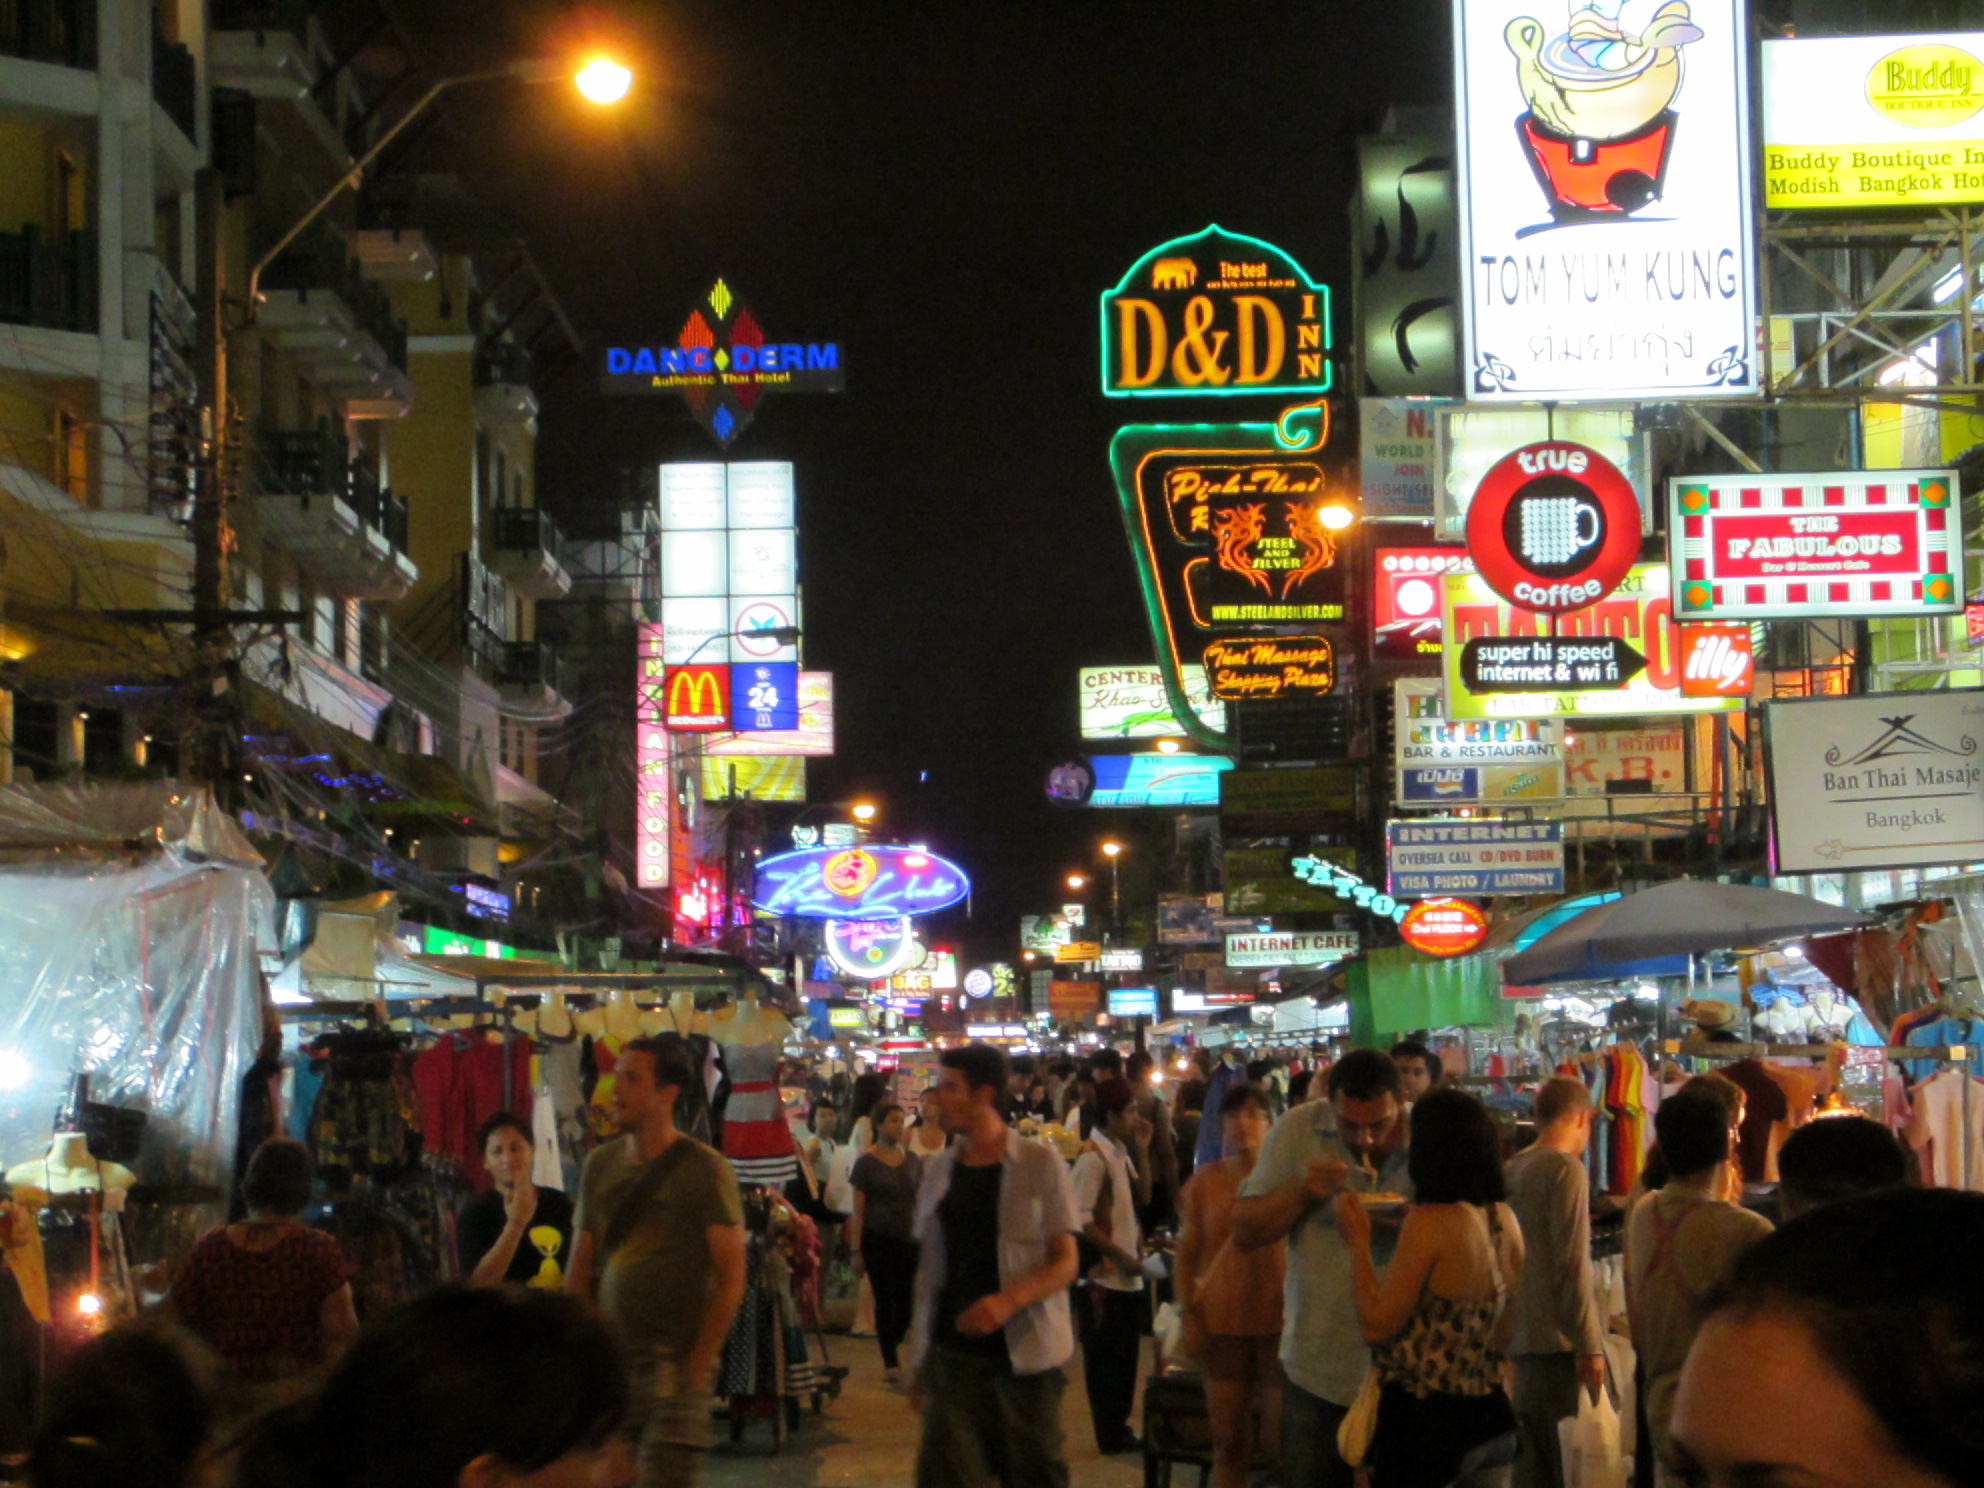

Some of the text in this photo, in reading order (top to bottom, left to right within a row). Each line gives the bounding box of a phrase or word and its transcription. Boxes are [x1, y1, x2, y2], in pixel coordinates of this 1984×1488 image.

[1886, 60, 1972, 96] Buddy
[1885, 99, 1944, 110] BOUTIQUE
[1769, 152, 1840, 173] Buddy
[1851, 150, 1952, 170] Boutique
[1769, 177, 1840, 194] Modish
[1858, 173, 1943, 196] Bangkok
[1219, 261, 1267, 278] The best
[1480, 248, 1737, 306] TOM YUM KUNG
[1115, 295, 1286, 387] D&D
[1297, 294, 1321, 378] INN
[607, 344, 839, 373] DANG DERM
[652, 372, 791, 387] Authentic Thai Hotel
[1375, 444, 1424, 457] WORLD
[1395, 463, 1425, 477] JOIN
[1517, 449, 1589, 474] true
[1368, 483, 1408, 496] SIGHT
[1789, 516, 1839, 533] THE
[1257, 537, 1296, 549] STEEL
[1728, 534, 1902, 559] FABULOUS
[1263, 549, 1290, 557] AND
[1252, 557, 1302, 569] SILVER
[1211, 605, 1343, 620] WWW.STEELANDSILVER.COM
[1209, 643, 1328, 668] Thai Massage
[1478, 642, 1614, 663] super hi speed
[1686, 634, 1748, 689] illy
[1085, 670, 1164, 688] CENTER
[1215, 665, 1329, 694] Shopping Plaza
[1477, 663, 1619, 681] internet & wi fi
[748, 686, 779, 710] 24
[1085, 689, 1146, 709] Khao
[1403, 744, 1557, 758] BAR & RESTAURANT
[1824, 763, 1981, 791] Ban Thai Masaje
[1866, 808, 1946, 831] Bangkok
[1399, 825, 1551, 842] INTERNET
[1399, 851, 1445, 865] OVERSEA
[1449, 850, 1473, 863] CALL
[766, 862, 833, 909] The
[1399, 875, 1430, 889] VISA
[1433, 875, 1477, 888] PHOTO
[1494, 873, 1555, 887] LAUNDRY
[1231, 935, 1353, 952] INTERNET CAFE
